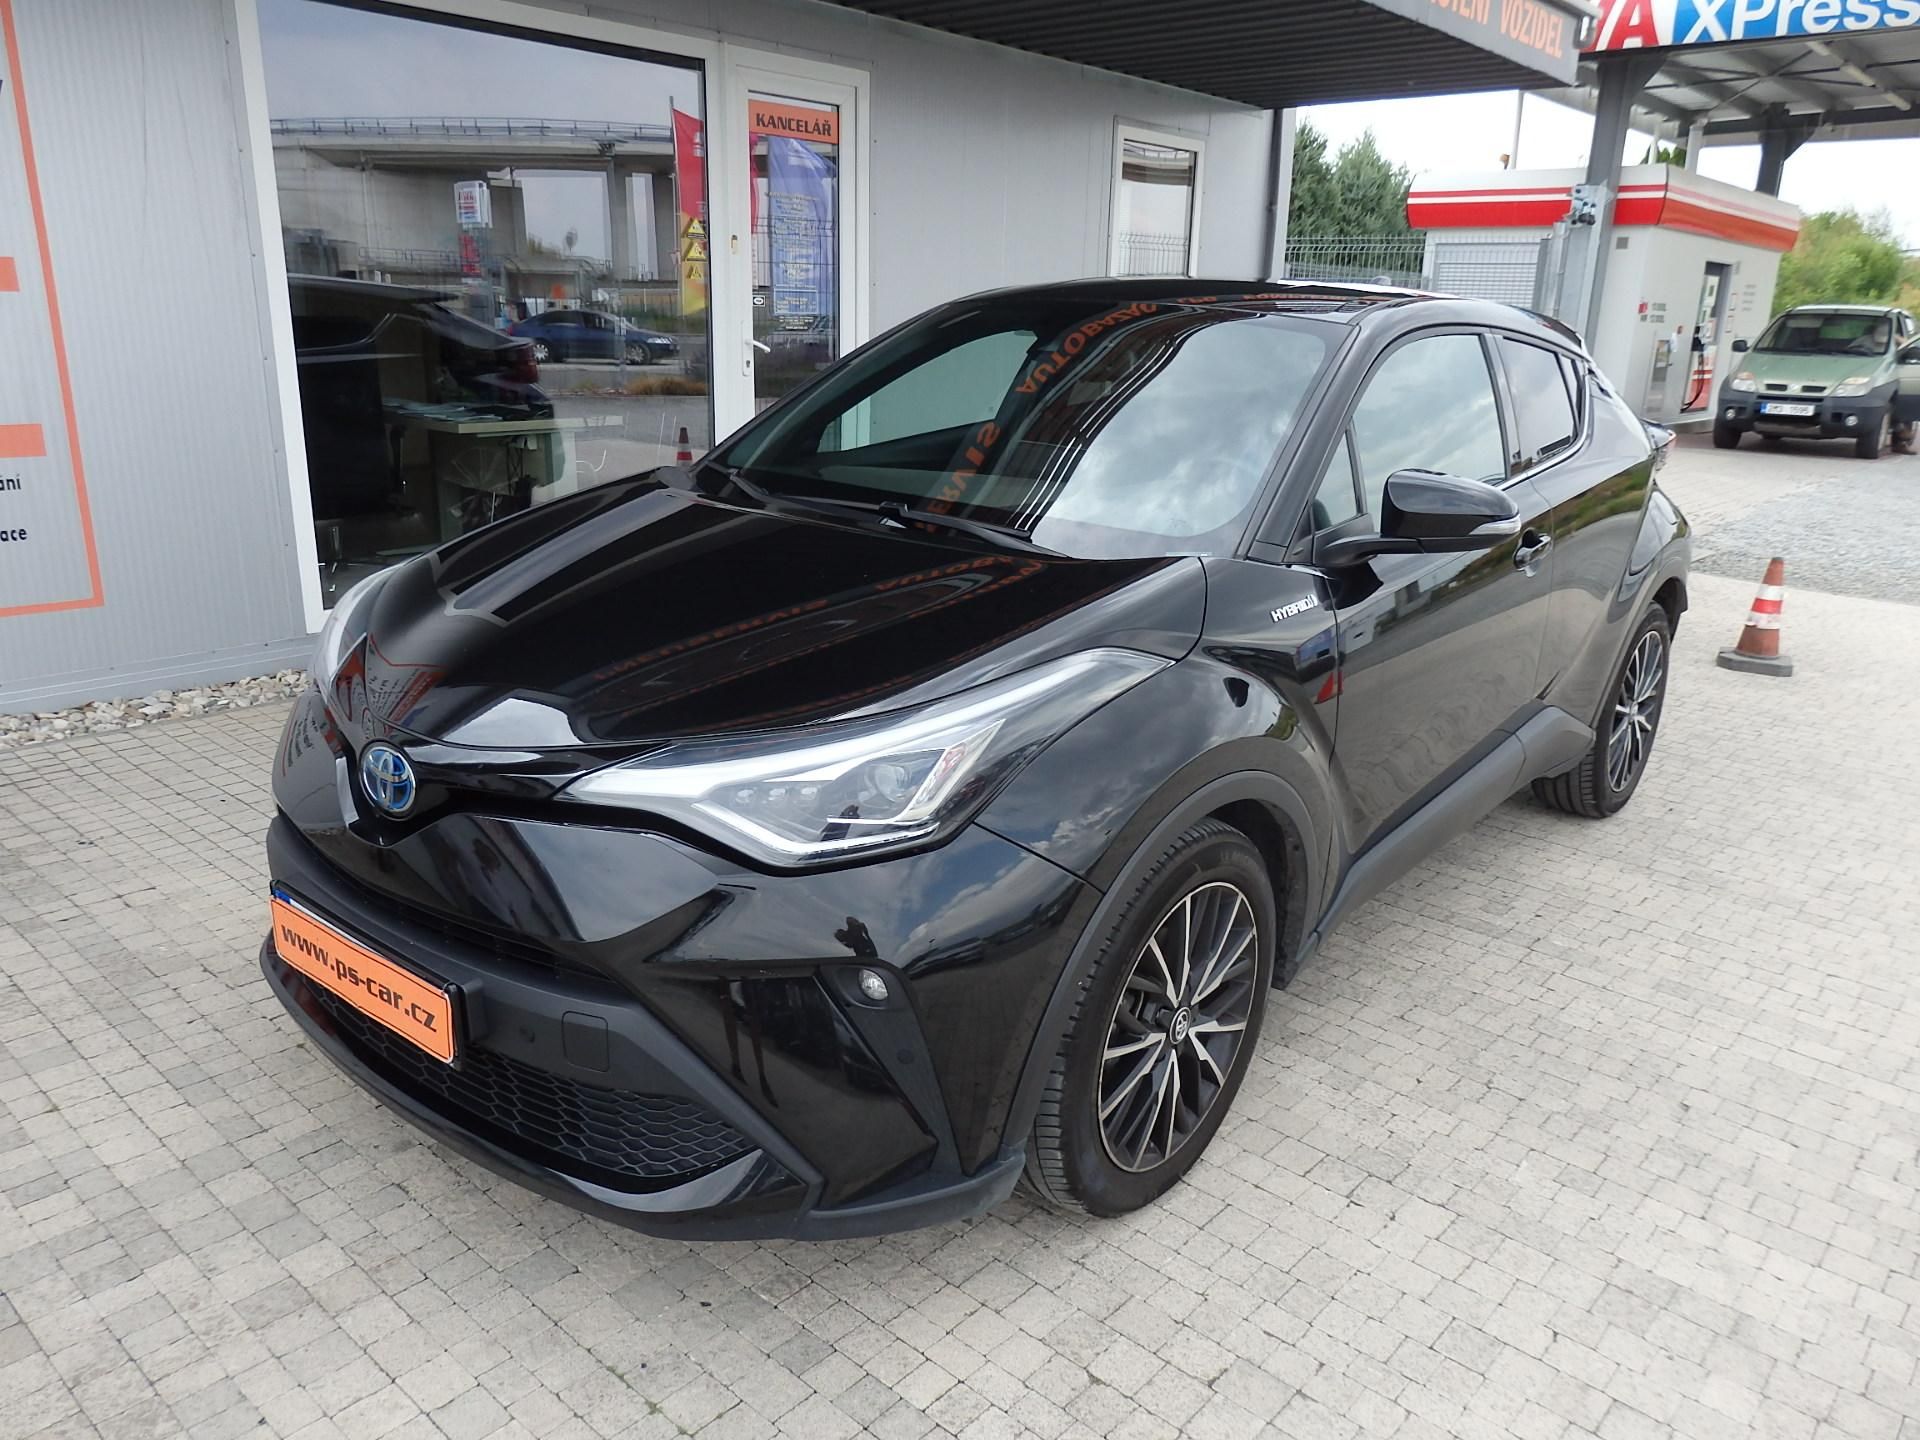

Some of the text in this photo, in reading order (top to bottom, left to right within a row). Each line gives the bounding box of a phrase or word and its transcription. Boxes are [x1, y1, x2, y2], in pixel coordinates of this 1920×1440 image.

[1500, 0, 1563, 58] VOZIDEL
[756, 113, 832, 136] KANCELÁŘ
[1270, 594, 1314, 622] HYBRID
[281, 924, 437, 1033] www.ps-car.cz
